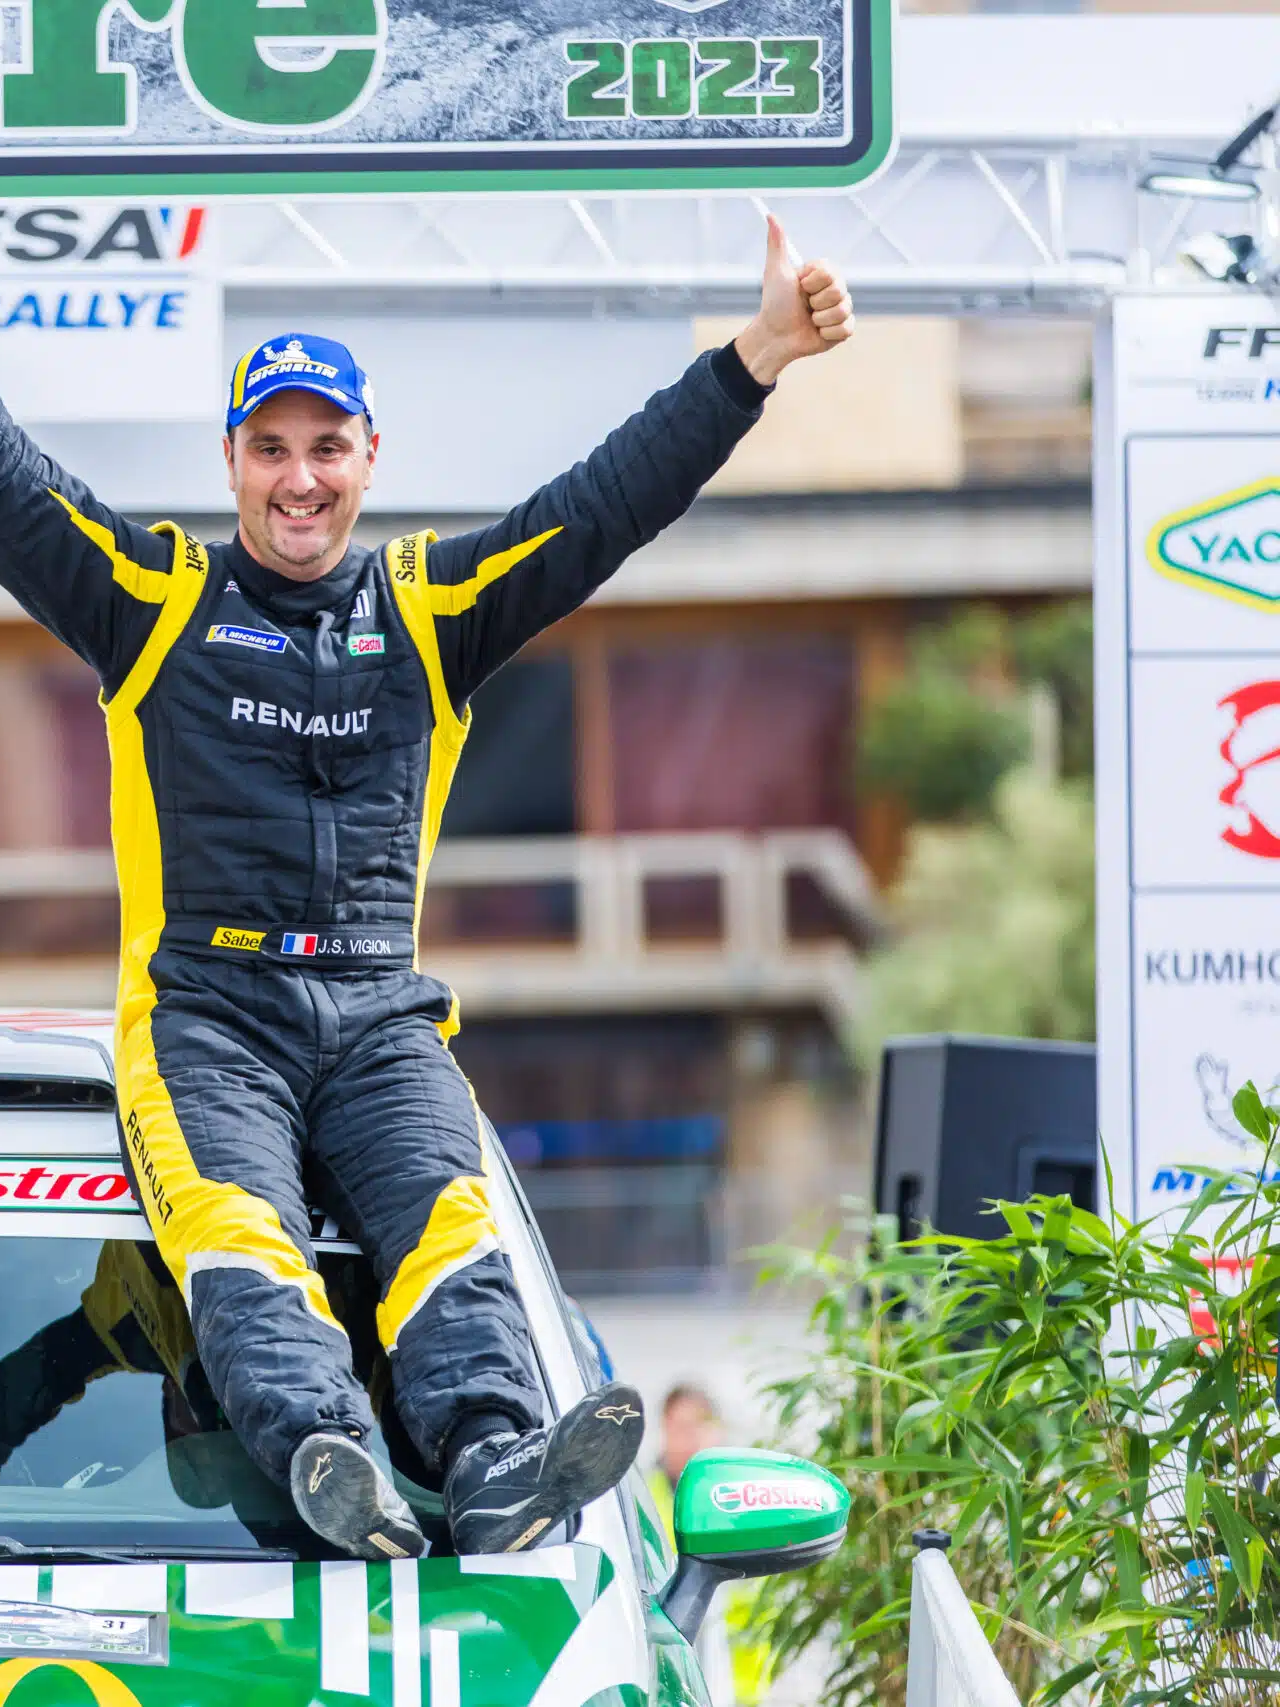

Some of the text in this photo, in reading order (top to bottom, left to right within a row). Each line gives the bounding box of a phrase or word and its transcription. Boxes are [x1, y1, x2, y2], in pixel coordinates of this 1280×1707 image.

[563, 36, 824, 121] 2023
[247, 363, 338, 388] MICHELIN
[228, 631, 280, 647] MICHELIN
[231, 697, 372, 737] RENAULT
[318, 939, 391, 955] J.S. VIGION
[126, 1108, 173, 1226] RENAULT
[484, 1438, 546, 1483] ASTARS
[102, 1619, 126, 1630] 31
